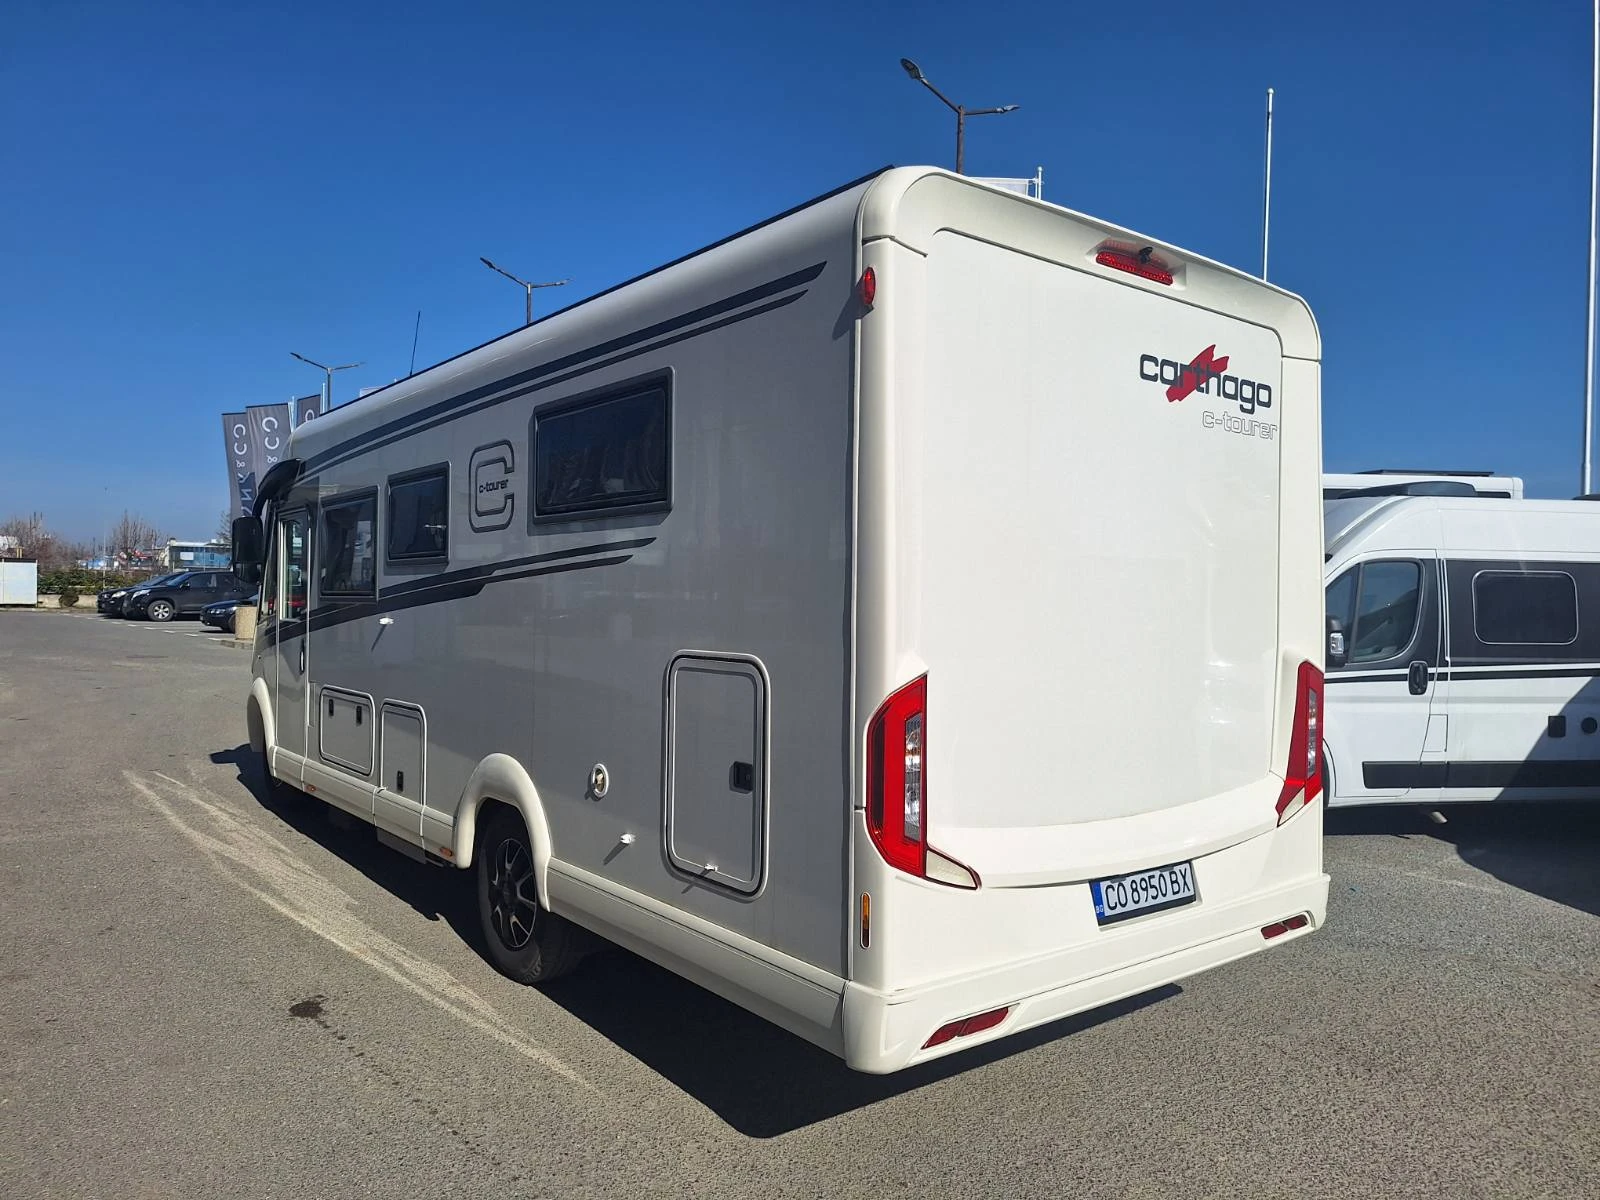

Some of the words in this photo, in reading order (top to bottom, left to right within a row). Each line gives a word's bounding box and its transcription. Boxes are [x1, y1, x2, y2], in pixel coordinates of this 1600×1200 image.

[1139, 353, 1272, 415] carthago
[1202, 411, 1277, 440] c-tourer
[478, 479, 509, 494] c-tourer
